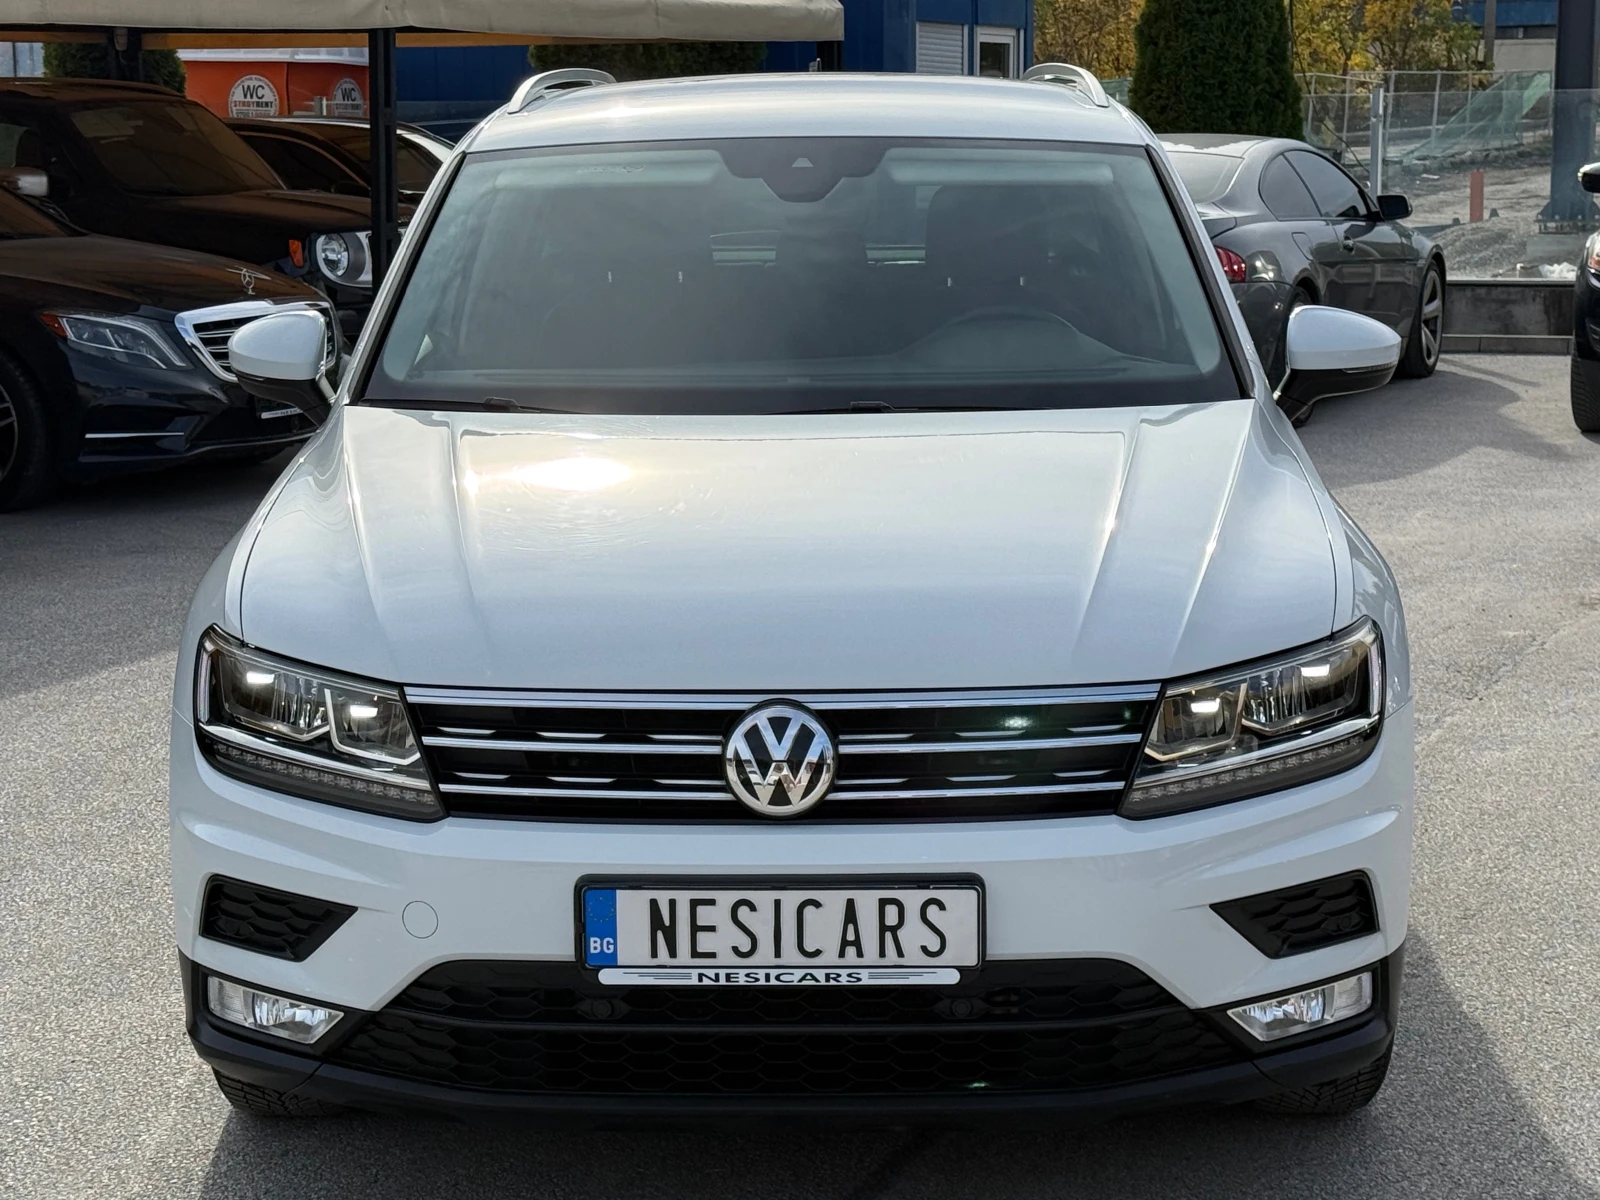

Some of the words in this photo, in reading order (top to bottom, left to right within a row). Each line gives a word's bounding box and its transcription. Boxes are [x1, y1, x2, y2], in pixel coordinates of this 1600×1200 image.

[242, 84, 265, 100] WC
[340, 87, 357, 102] WC
[648, 897, 948, 960] NESICARS
[589, 937, 615, 954] BG
[697, 971, 863, 984] NESICARS
